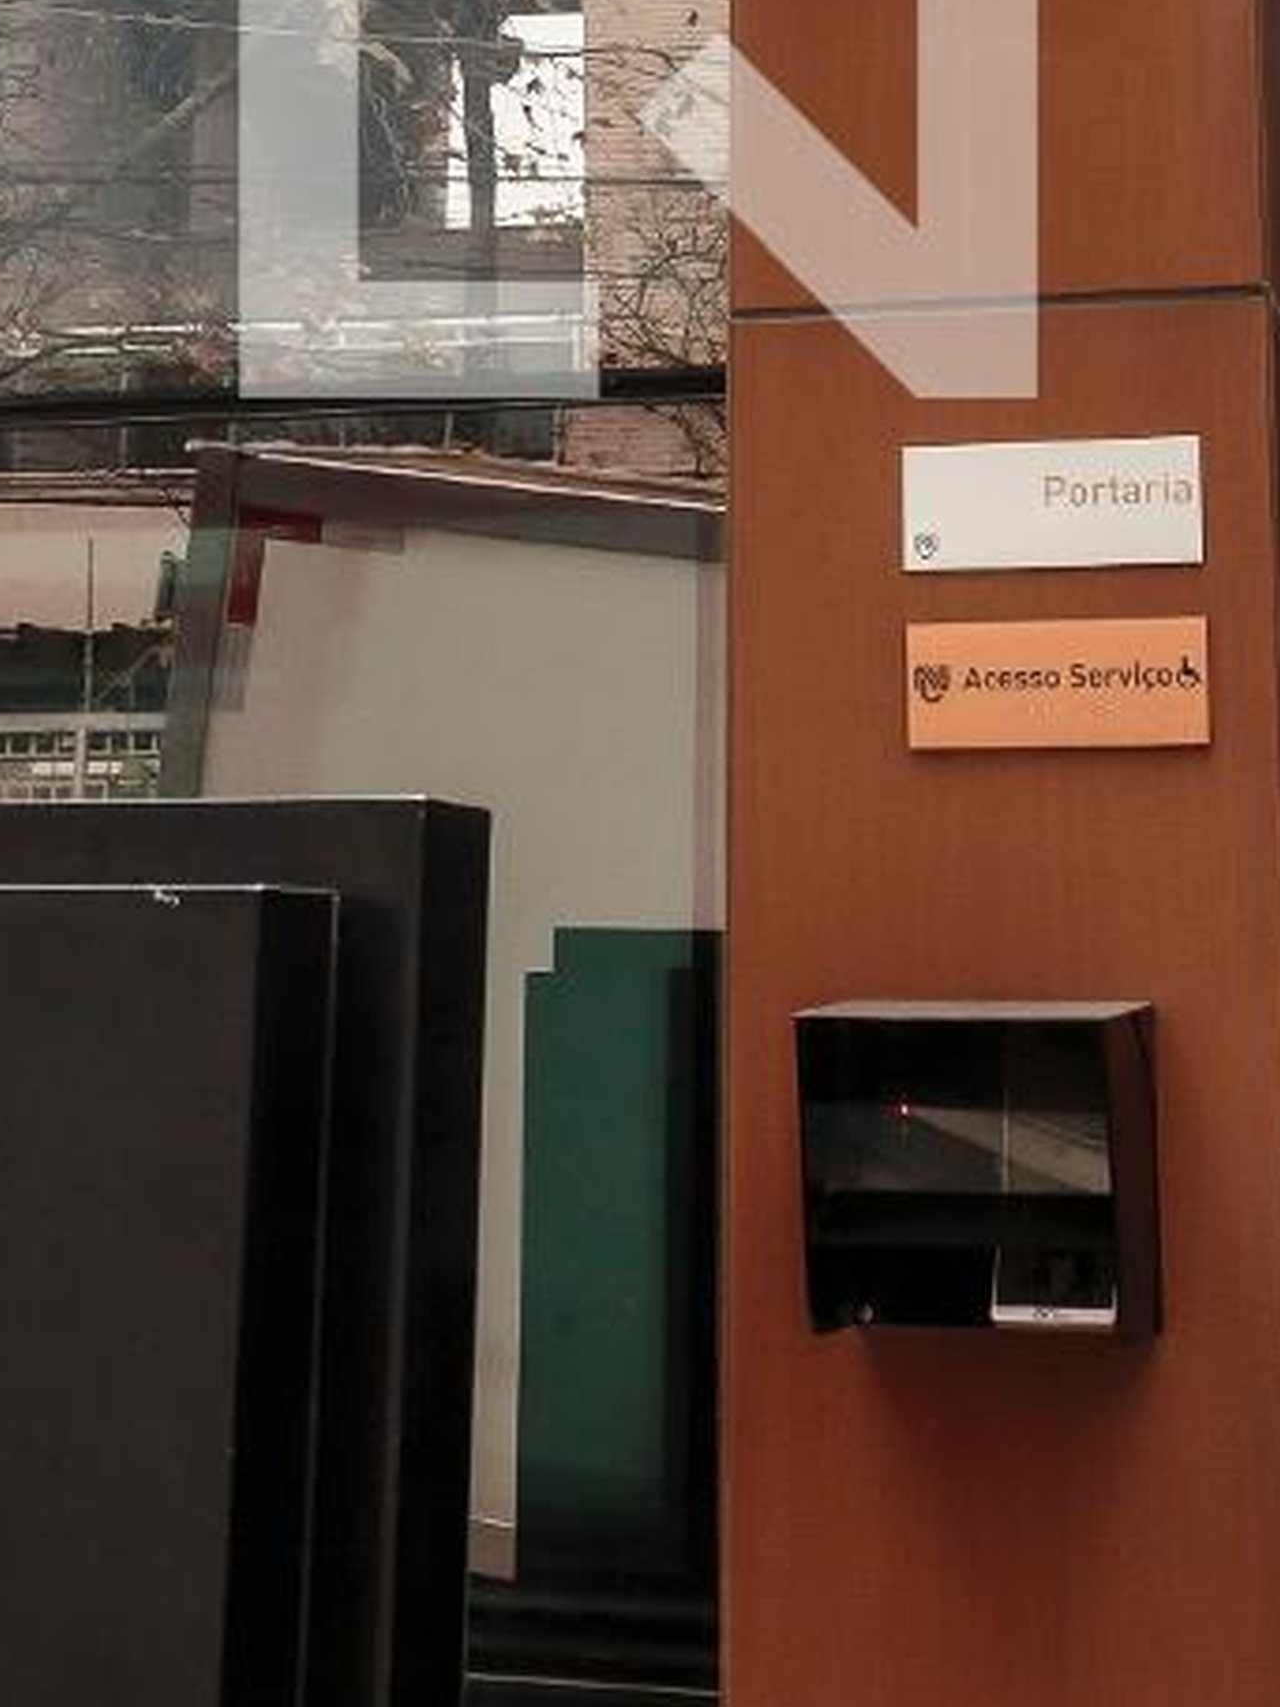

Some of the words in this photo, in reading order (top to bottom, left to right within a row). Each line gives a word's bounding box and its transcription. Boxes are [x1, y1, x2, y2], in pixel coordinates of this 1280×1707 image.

[1044, 473, 1193, 508] Portaria
[964, 666, 1061, 689] Acesso
[1070, 659, 1171, 693] Serviço
